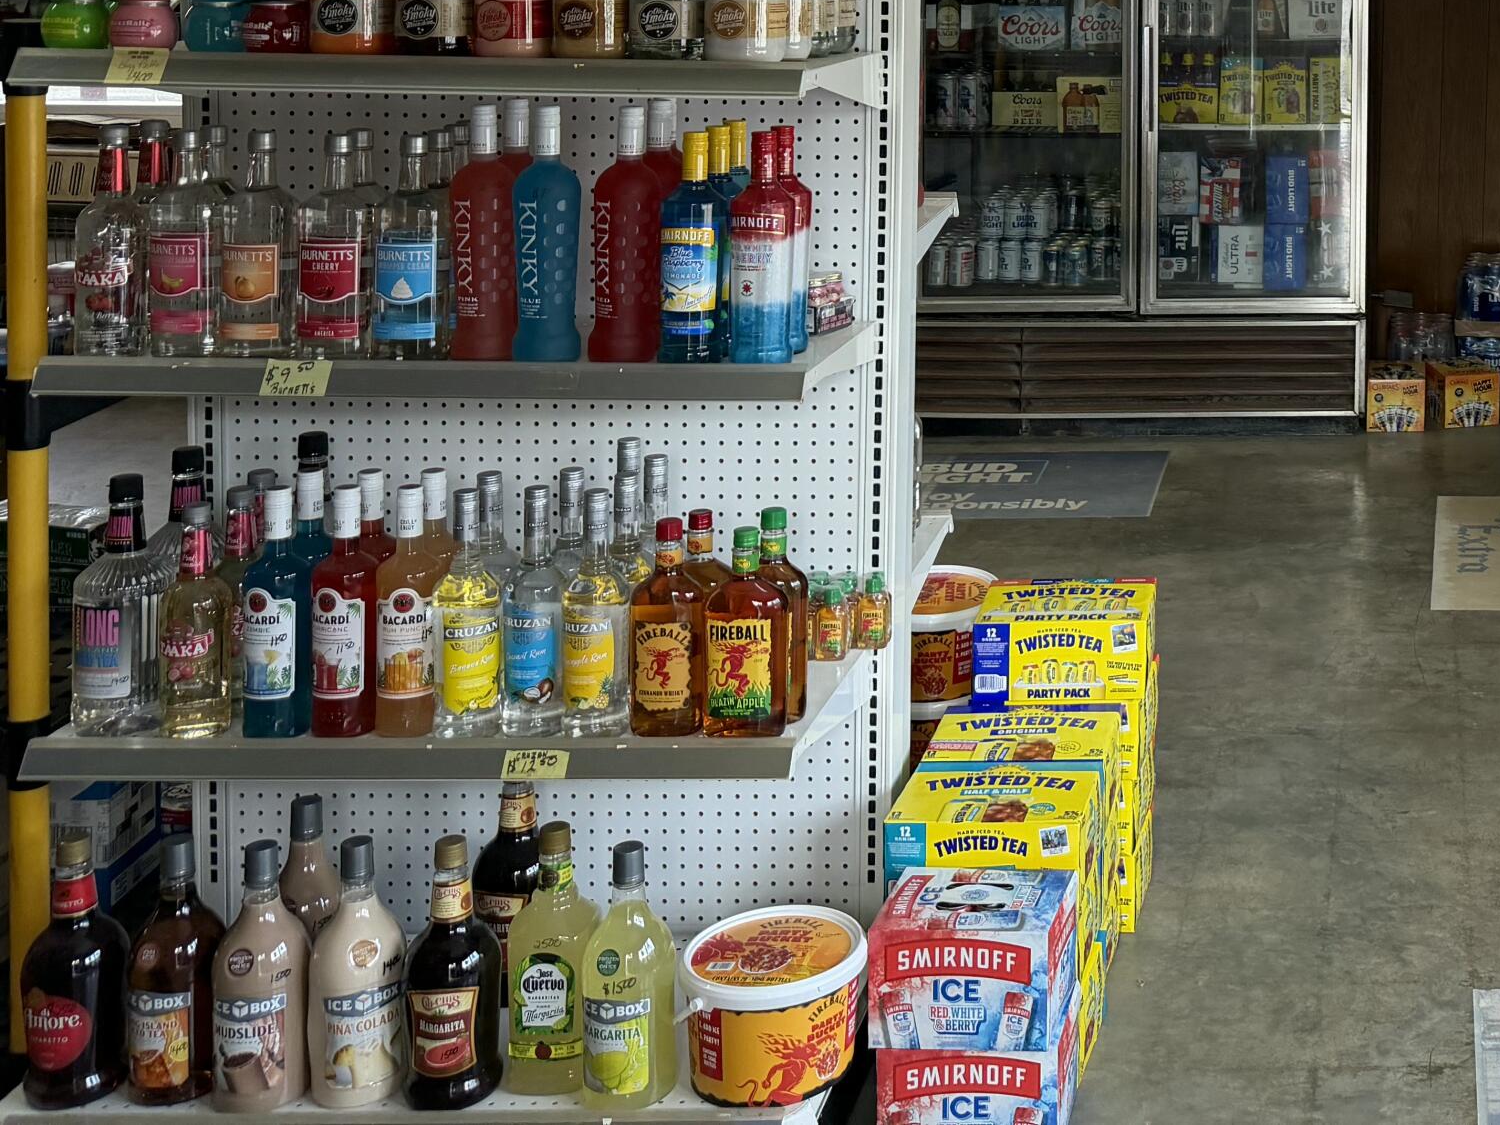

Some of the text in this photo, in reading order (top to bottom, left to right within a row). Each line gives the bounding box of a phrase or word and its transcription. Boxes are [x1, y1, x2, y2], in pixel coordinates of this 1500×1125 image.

[1307, 0, 1337, 18] Lite
[1001, 14, 1061, 36] Coors
[1015, 36, 1048, 44] LIGHT
[1159, 92, 1214, 104] TWISTED TEA
[1287, 187, 1295, 212] LIGHT
[732, 216, 780, 228] MIRNOFF
[301, 249, 354, 261] BURNETT'S
[454, 198, 472, 295] KINKY
[519, 199, 538, 296] KINKY
[595, 199, 611, 296] KINKY
[670, 246, 693, 258] Blue
[377, 250, 431, 262] BURNETT'S
[311, 261, 340, 271] CHERRY
[921, 472, 1032, 484] IGHT
[1002, 587, 1137, 600] TWISTED TEA
[80, 608, 120, 647] LONG
[445, 620, 499, 639] CRUZAN
[637, 626, 690, 645] FIREBALL
[709, 624, 768, 642] FIREBALL
[986, 628, 997, 638] 12
[1015, 633, 1076, 655] TWISTED
[1078, 635, 1104, 654] TEA
[450, 653, 496, 674] Banana Rum
[1026, 687, 1091, 699] PARTY PACK
[737, 697, 766, 709] APPLE
[997, 727, 1051, 735] ORIGINAL
[934, 835, 999, 858] TWISTED
[1001, 837, 1029, 858] TEA
[892, 877, 925, 916] SMIRNOFF
[917, 885, 944, 906] ICE
[897, 947, 1017, 972] SMIRNOFF
[536, 968, 555, 978] Jose
[522, 976, 565, 993] Cuervo
[932, 979, 982, 1003] ICE
[250, 997, 281, 1014] BOX
[327, 985, 400, 1012] ICE BOX
[523, 1005, 566, 1023] Margarita
[808, 993, 848, 1023] FIREBALL
[951, 1007, 983, 1019] WHITE
[419, 1018, 466, 1033] MARGARITA
[811, 1010, 846, 1033] PARTY
[215, 1024, 276, 1040] MUDSLIDE
[906, 1063, 1027, 1090] SMIRNOFF
[942, 1096, 992, 1121] ICE
